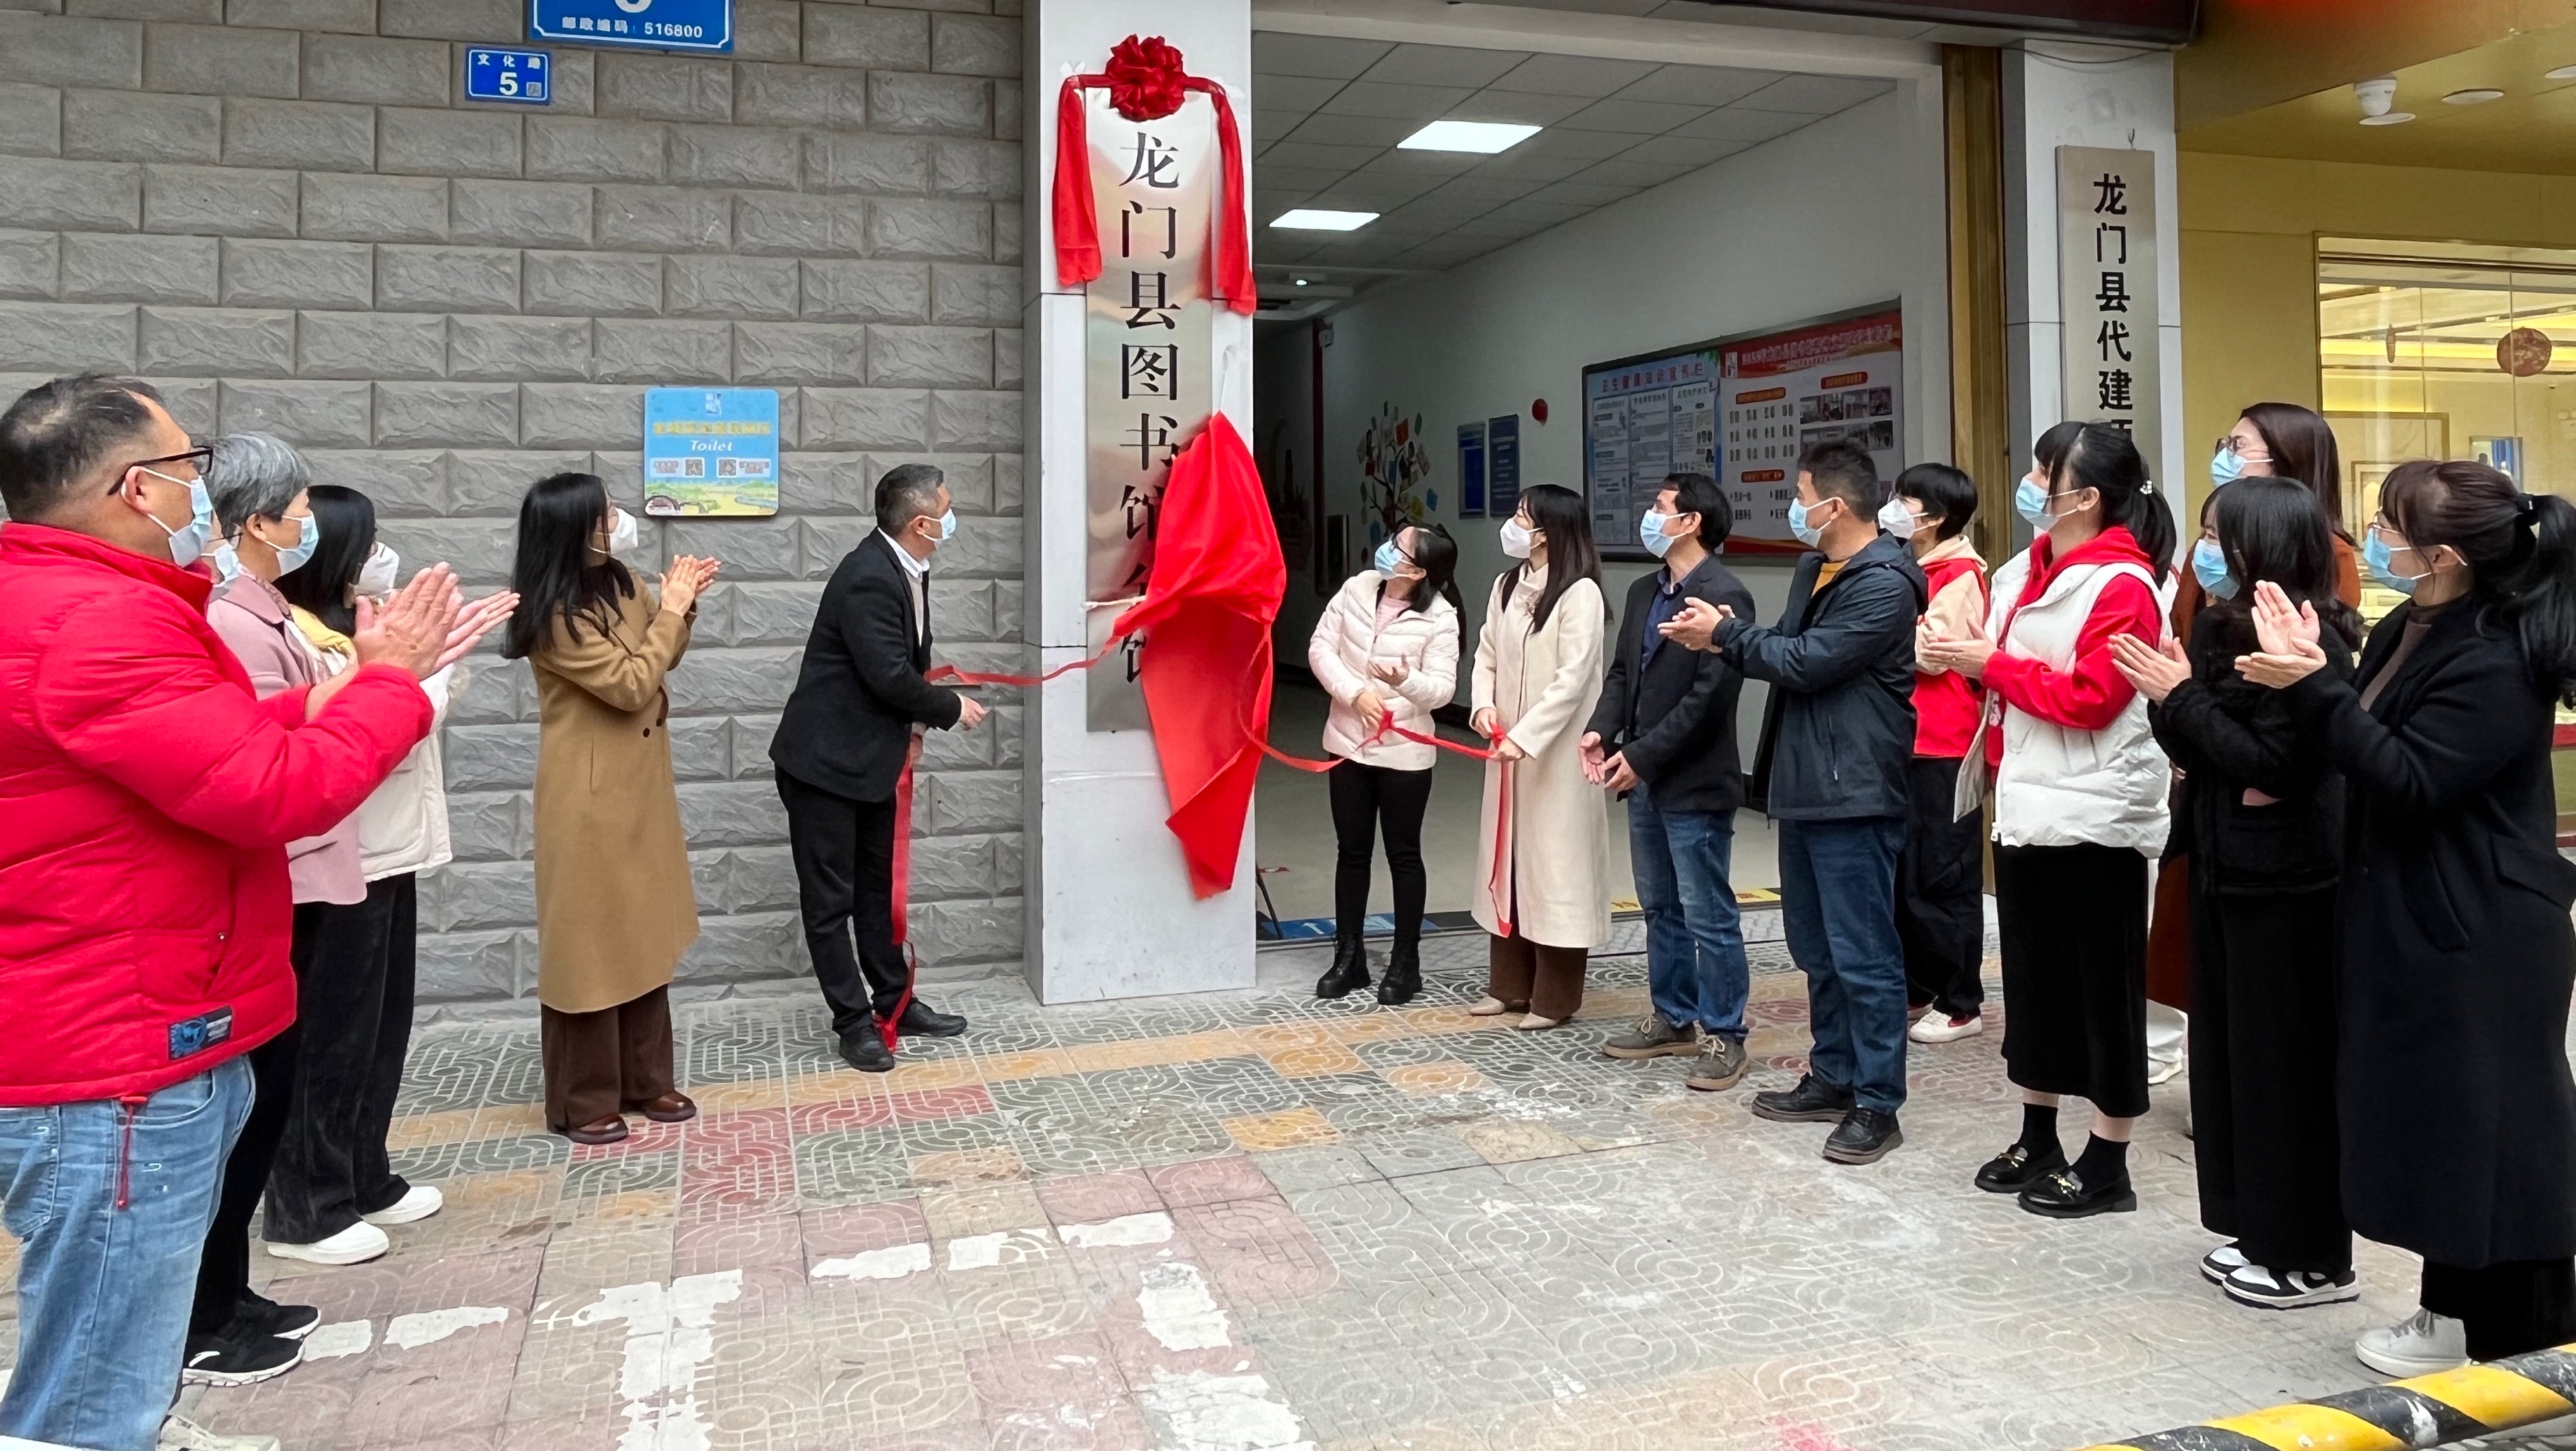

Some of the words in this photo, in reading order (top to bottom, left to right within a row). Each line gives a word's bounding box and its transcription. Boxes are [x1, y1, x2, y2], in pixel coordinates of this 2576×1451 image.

[644, 22, 703, 37] 516800
[499, 72, 518, 95] 5
[691, 439, 733, 452] Toilet
